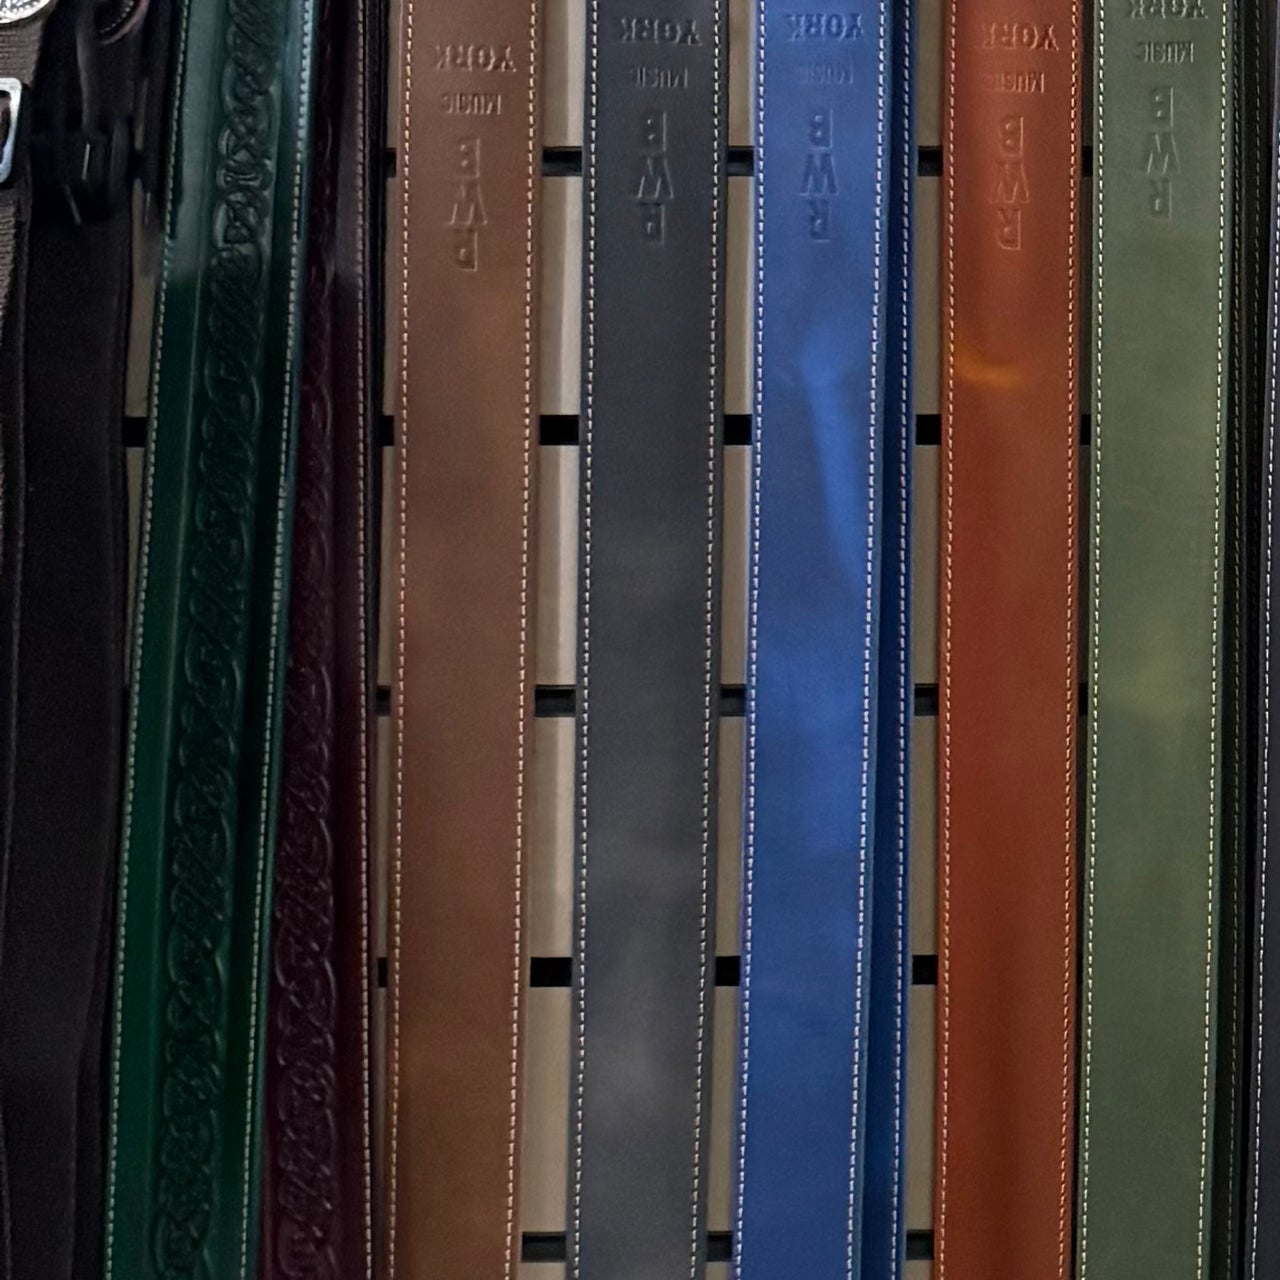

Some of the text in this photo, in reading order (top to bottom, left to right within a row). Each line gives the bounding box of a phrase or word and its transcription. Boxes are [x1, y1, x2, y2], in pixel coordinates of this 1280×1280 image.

[620, 18, 702, 47] YORK
[785, 14, 864, 41] YORK
[434, 44, 517, 73] YORK
